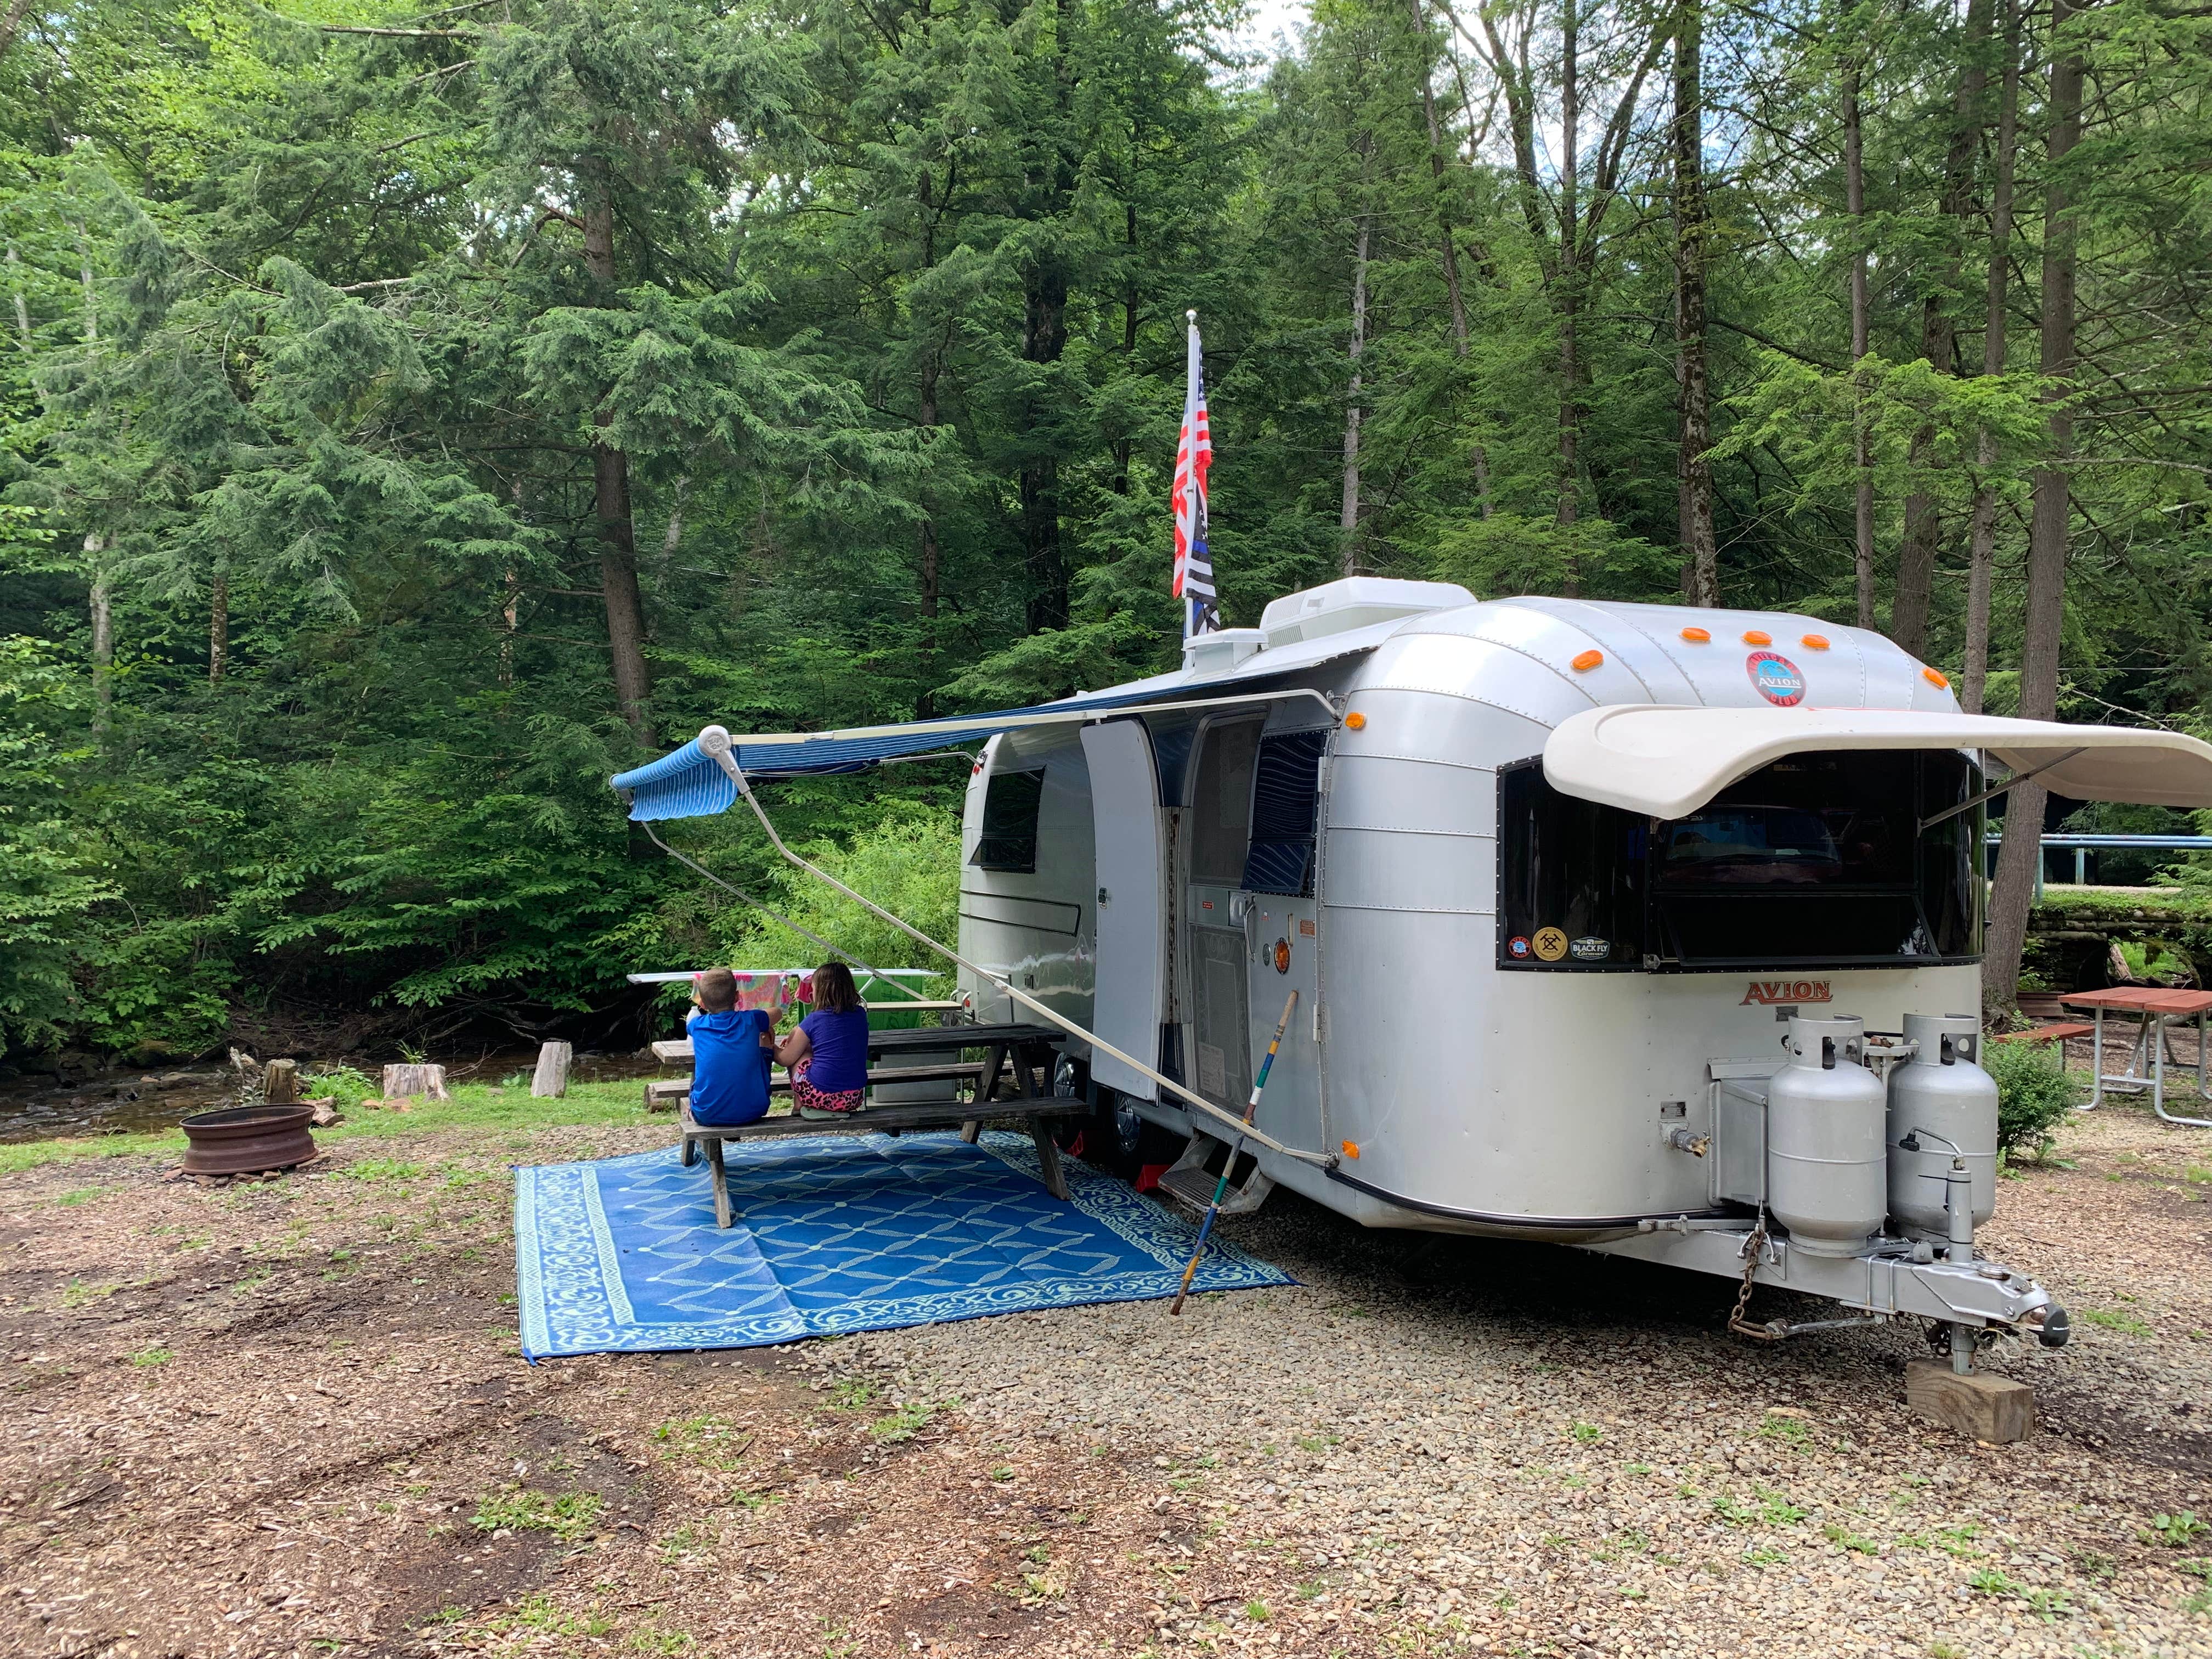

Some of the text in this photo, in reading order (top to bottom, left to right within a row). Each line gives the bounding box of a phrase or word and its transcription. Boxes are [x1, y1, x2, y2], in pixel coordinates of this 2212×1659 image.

[1759, 678, 1802, 688] AVION
[1770, 693, 1798, 706] CLUB
[1739, 980, 1833, 1006] AVION
